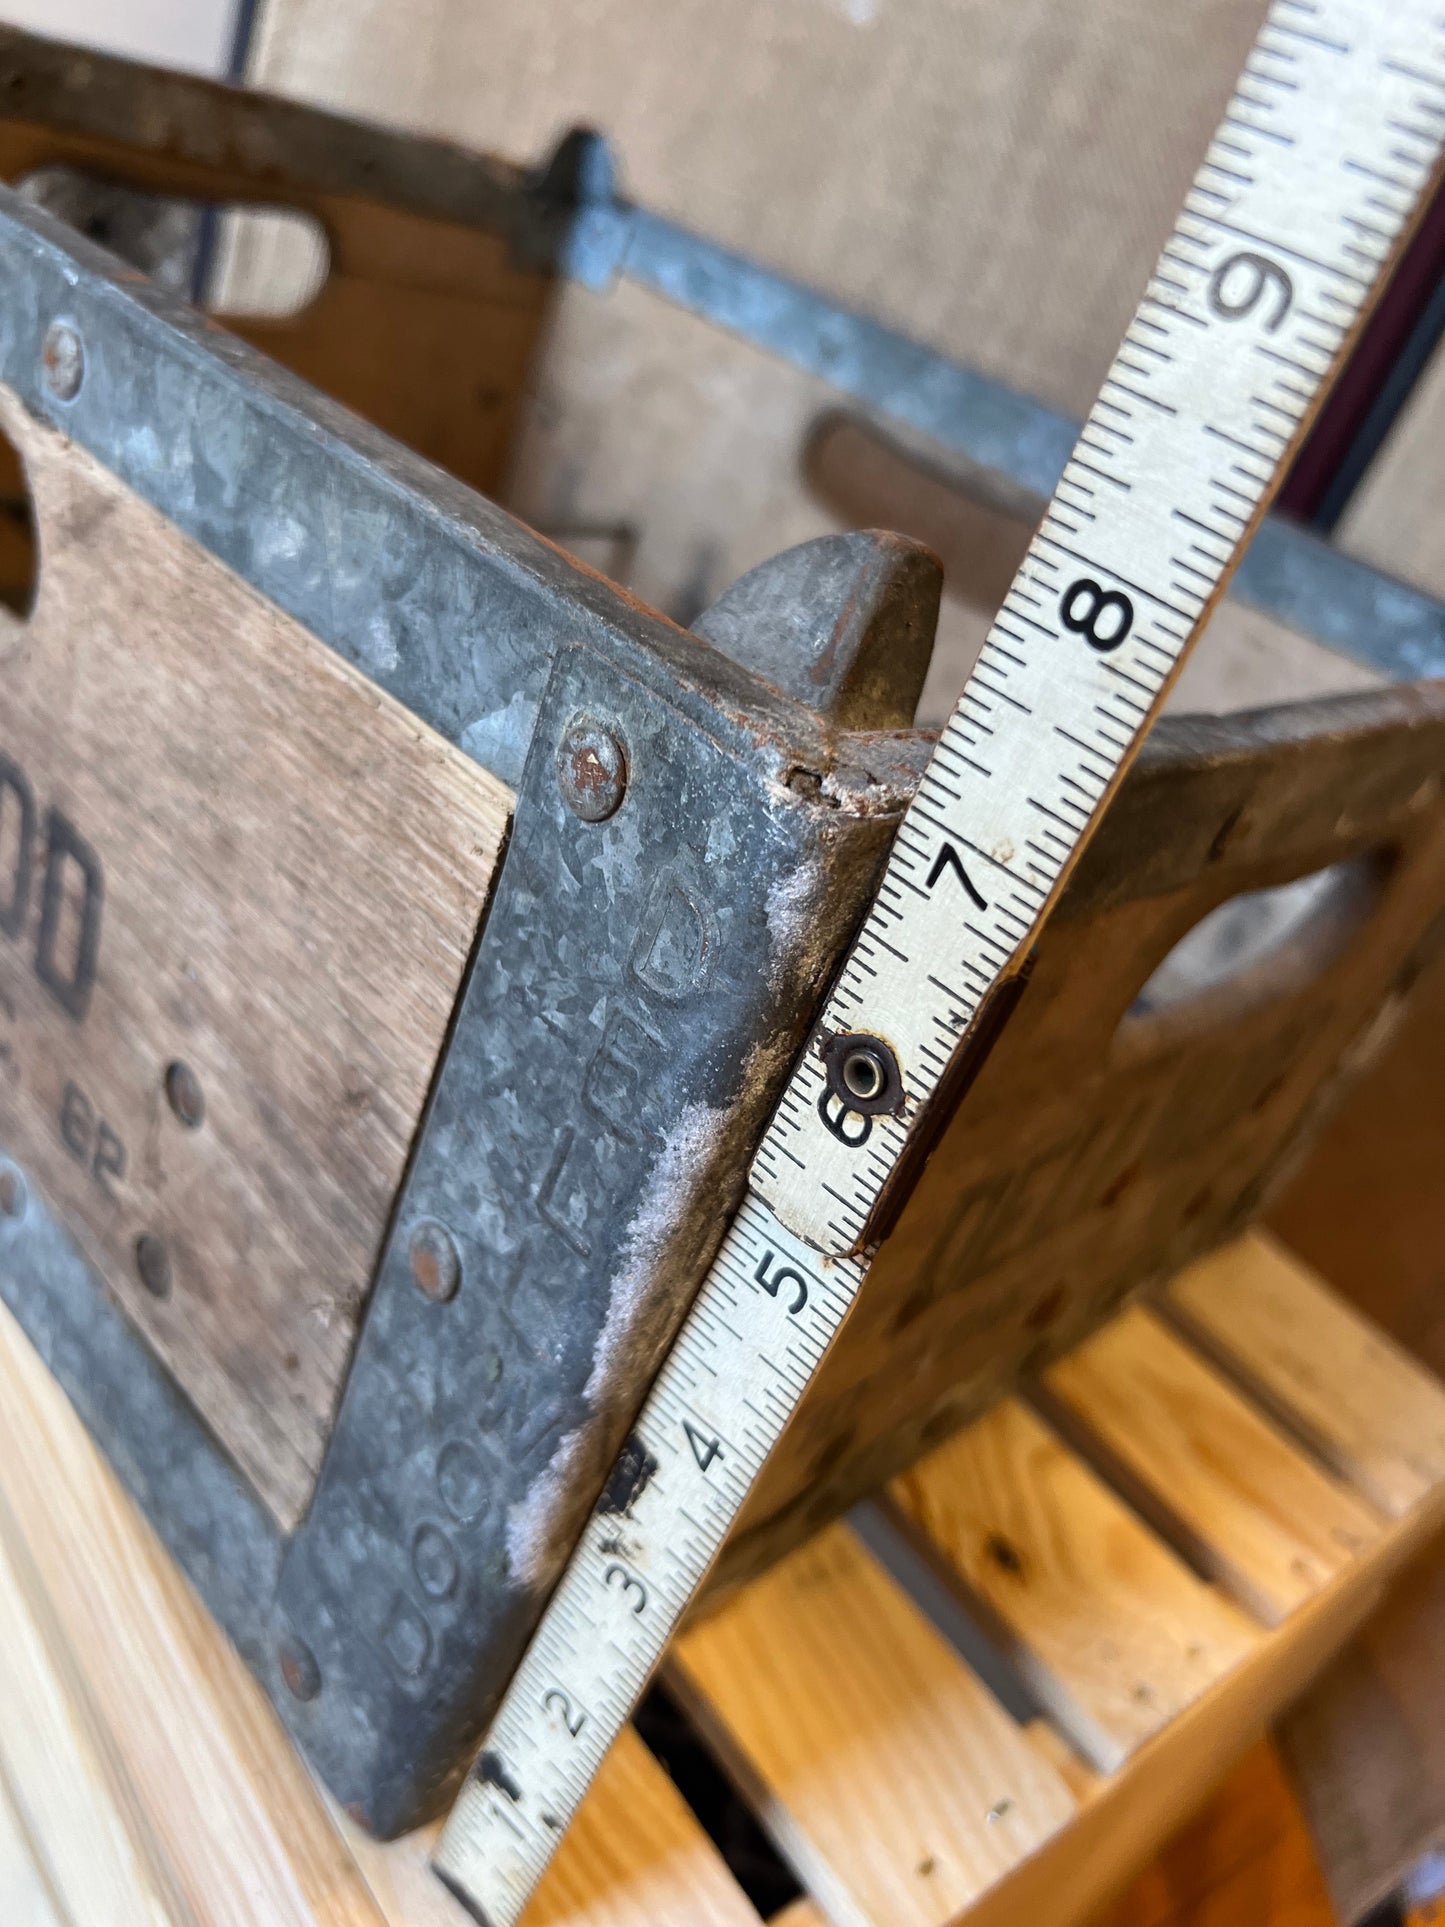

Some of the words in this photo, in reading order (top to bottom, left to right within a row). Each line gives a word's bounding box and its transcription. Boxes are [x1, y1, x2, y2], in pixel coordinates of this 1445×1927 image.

[1208, 251, 1294, 335] 9
[1059, 577, 1134, 652] 8
[926, 841, 988, 911] 7
[753, 1248, 808, 1316] 5
[682, 1418, 725, 1472] 4
[605, 1561, 648, 1615] 3
[541, 1686, 588, 1738] 2
[492, 1803, 526, 1840] 1
